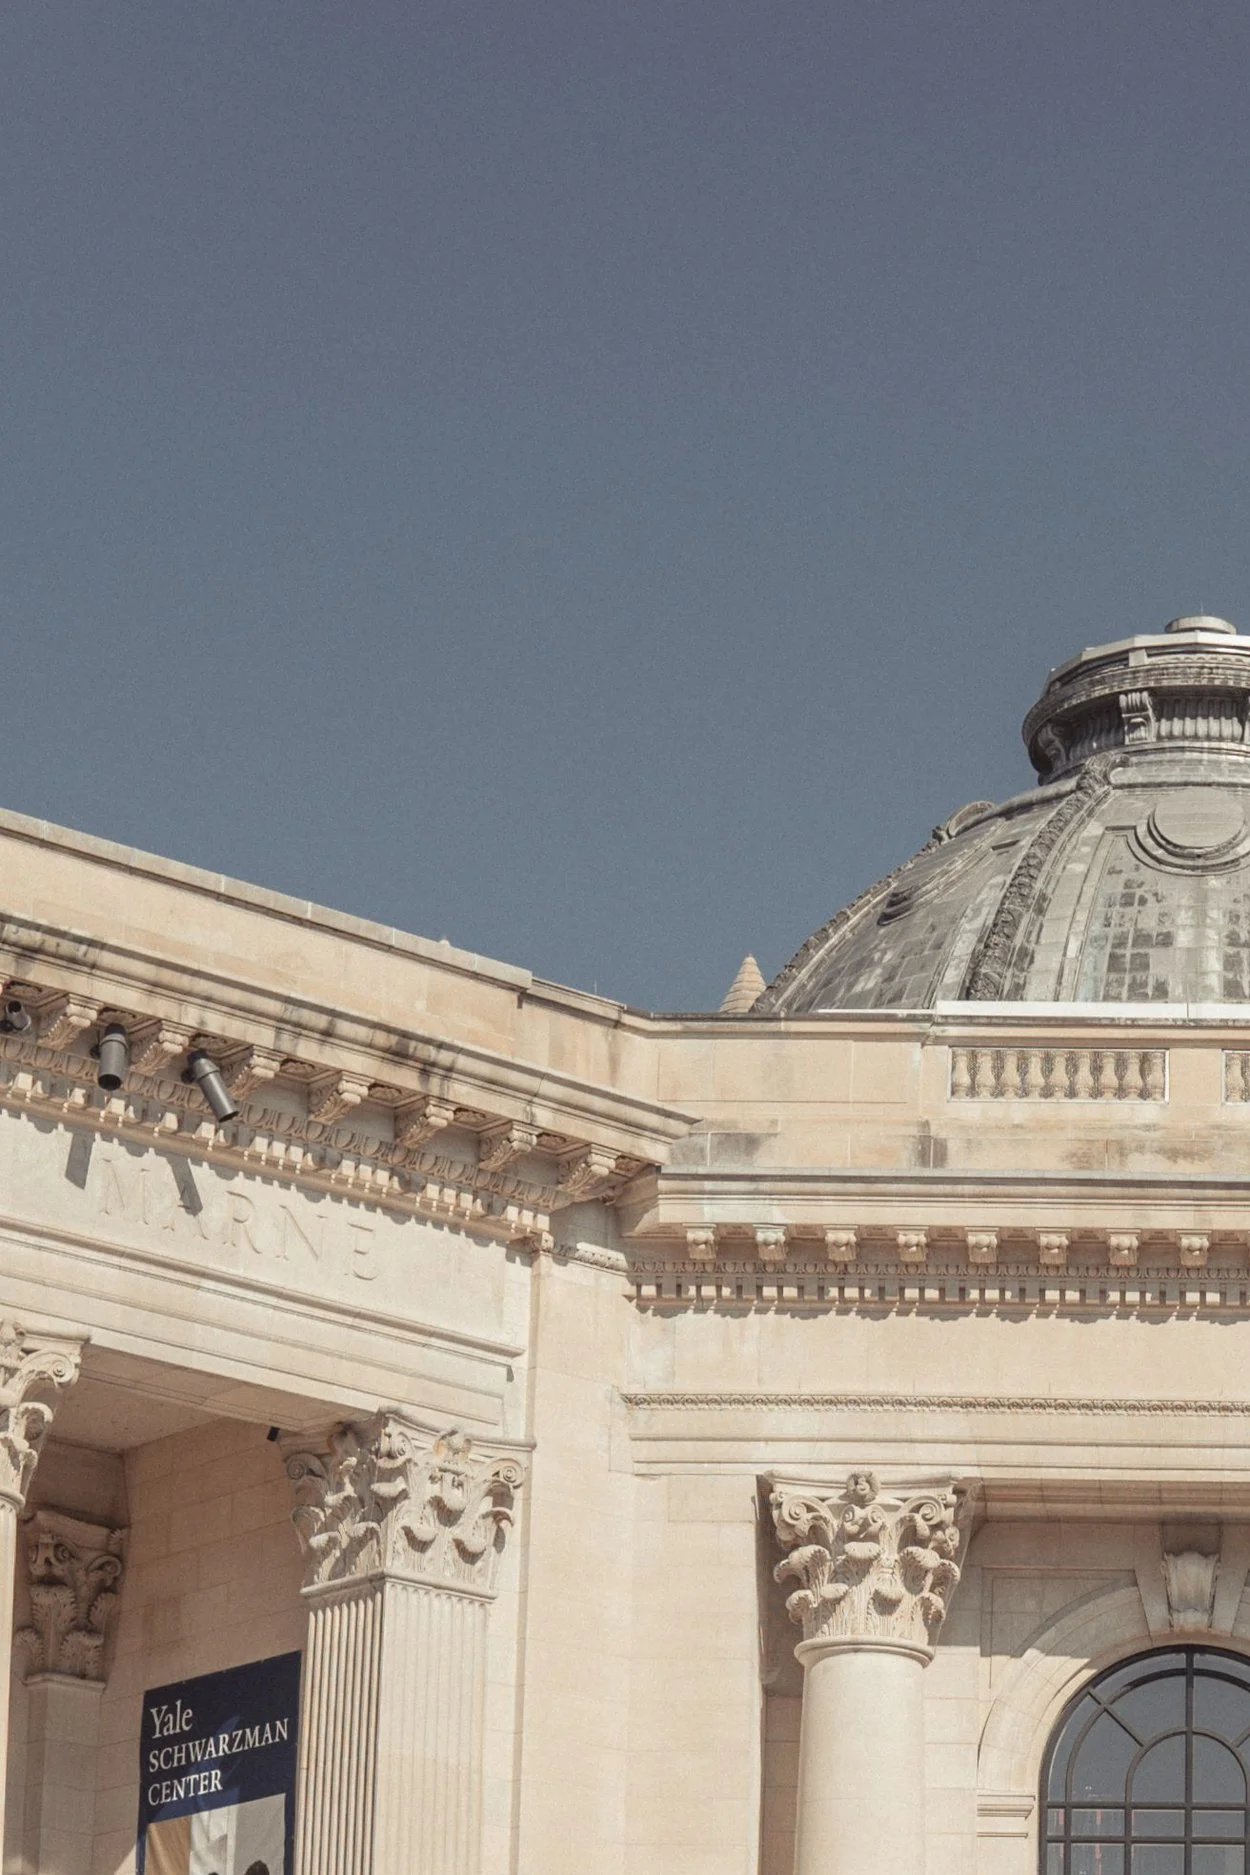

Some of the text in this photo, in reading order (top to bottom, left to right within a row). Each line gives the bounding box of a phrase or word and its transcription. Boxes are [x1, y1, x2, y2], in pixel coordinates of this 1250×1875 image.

[100, 1157, 379, 1281] MARNE
[150, 1700, 193, 1739] Yale
[149, 1718, 289, 1772] SCHWARZMAN
[148, 1769, 223, 1806] CENTER
